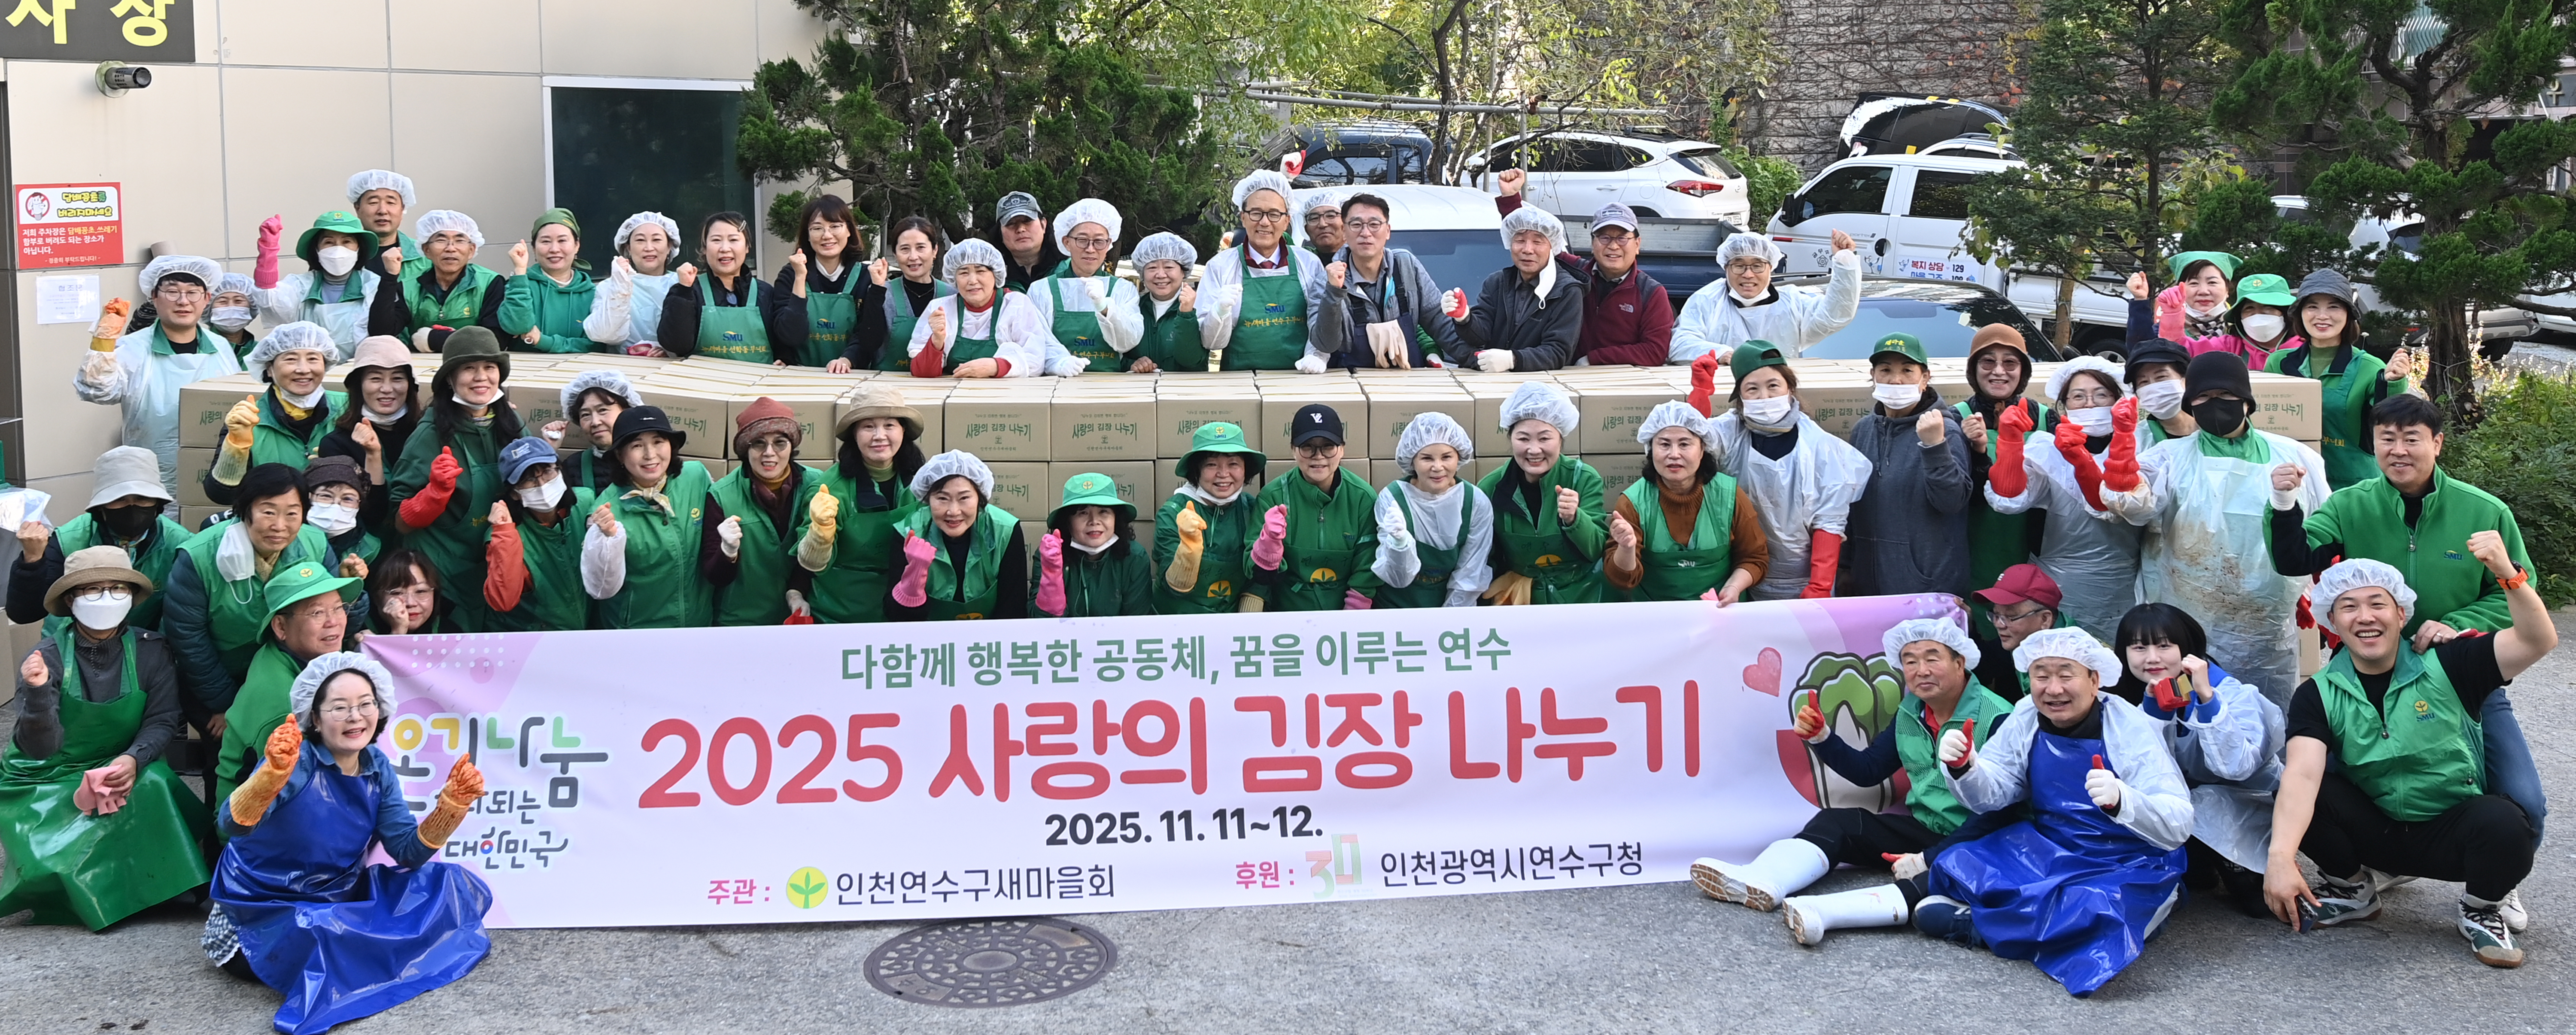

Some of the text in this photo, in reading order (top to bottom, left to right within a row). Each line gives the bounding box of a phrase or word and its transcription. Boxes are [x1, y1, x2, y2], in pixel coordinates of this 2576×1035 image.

[38, 228, 66, 236] 주차장은
[23, 238, 44, 246] 함부로
[46, 237, 66, 245] 버려도
[83, 235, 104, 243] 장소가
[24, 246, 54, 255] 아닙니다.
[1911, 260, 1964, 273] 복지 상담 129
[1265, 304, 1285, 314] SMU
[817, 320, 835, 329] SMU
[723, 333, 743, 341] SMU
[1074, 338, 1094, 346] SMU
[200, 410, 222, 425] 사랑의
[529, 408, 551, 423] 사랑의
[1838, 408, 1853, 416] 김장
[2264, 403, 2303, 422] 김장 나누기
[684, 417, 707, 437] 나누기
[1177, 419, 1199, 435] 사랑의
[1602, 416, 1641, 431] 사랑의 김장
[966, 423, 1031, 442] 사랑의 김장 나누기
[1072, 422, 1137, 441] 사랑의 김장 나누기
[1602, 476, 1624, 490] 사랑의
[1007, 484, 1029, 502] 나누기
[2444, 552, 2462, 560] SMU
[842, 628, 1511, 689] 다함께 행복한 공동체, 꿈을 이루는 연수
[2416, 713, 2435, 722] SMU
[638, 680, 1701, 809] 2025 사랑의 김장 나누기
[1045, 804, 1323, 846] 2025. 11. 11~12.
[445, 826, 568, 869] 대한민국
[1236, 861, 1280, 889] 후원
[1288, 869, 1294, 885] :
[1381, 841, 1643, 888] 인천광역시연수구청
[708, 863, 1114, 905] 주관 : 인천연수구새마을회
